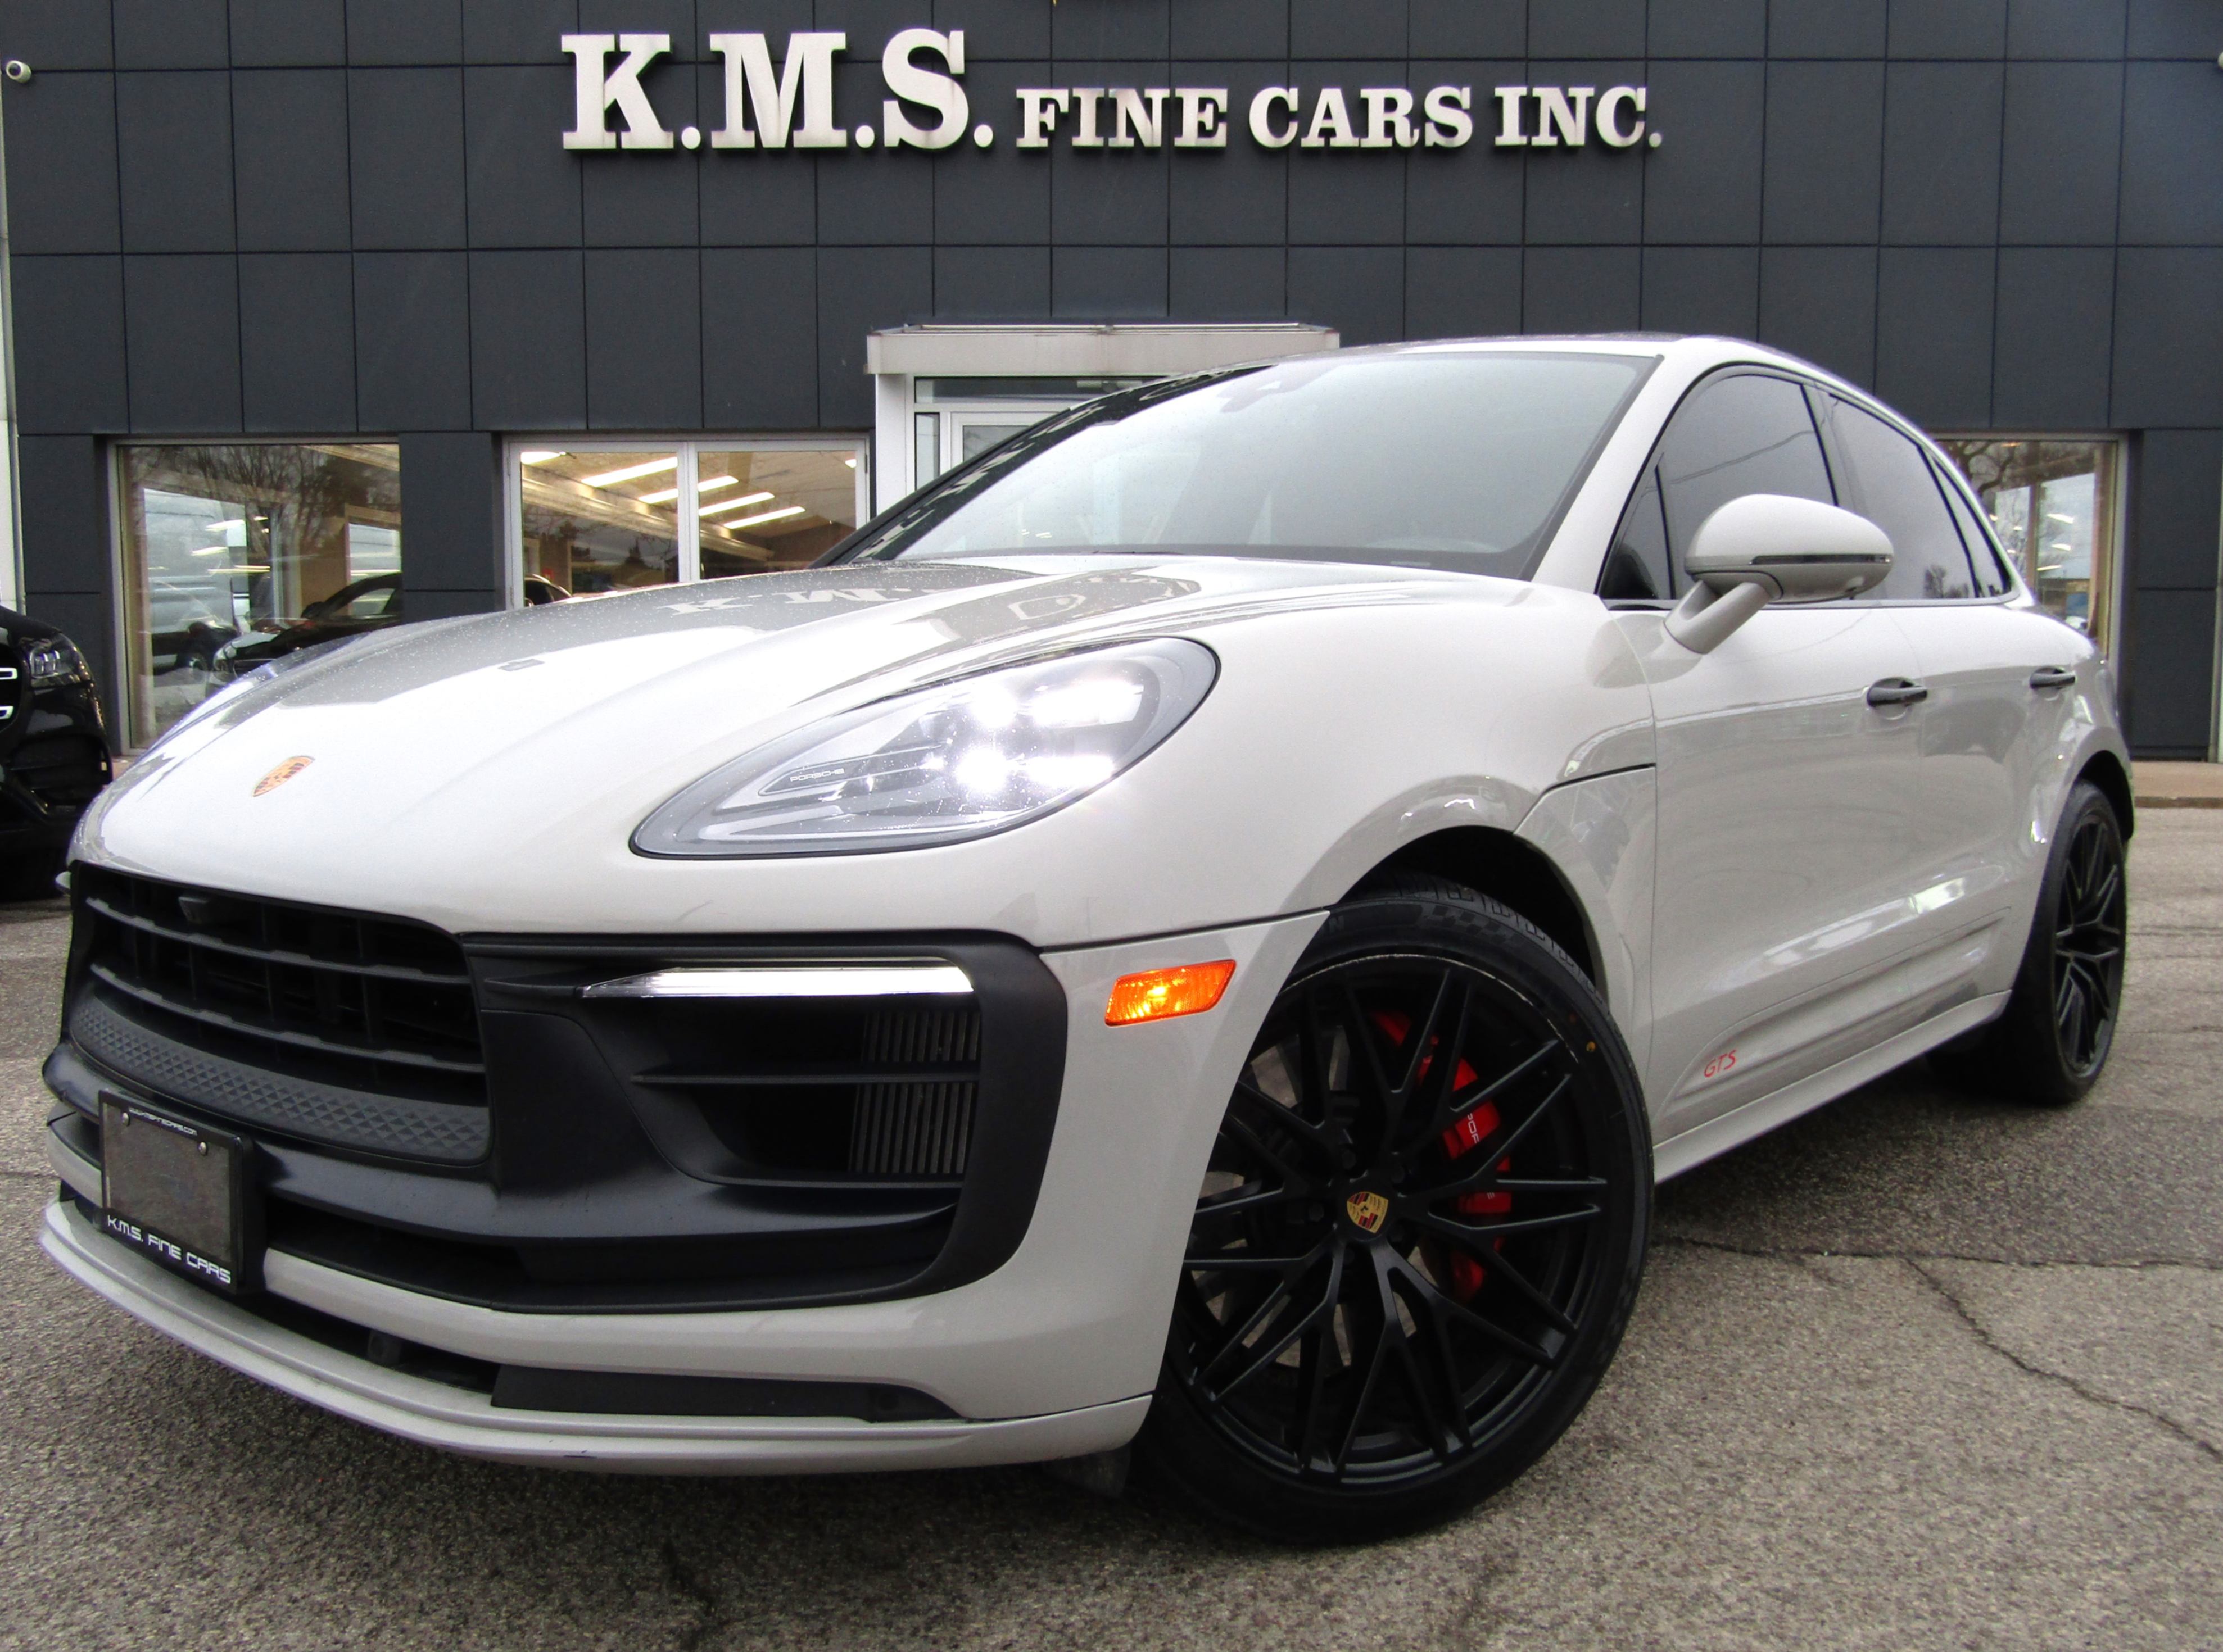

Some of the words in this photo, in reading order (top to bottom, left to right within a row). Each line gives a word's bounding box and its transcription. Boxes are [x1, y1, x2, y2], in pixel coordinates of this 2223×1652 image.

[561, 28, 994, 150] K.M.S.
[1016, 88, 1228, 148] FINE
[1248, 86, 1474, 148] CARS
[1494, 86, 1663, 148] INC.
[789, 768, 845, 783] PORSCHE
[1704, 1049, 1737, 1078] GTS
[147, 1233, 182, 1261] FINE
[186, 1251, 231, 1285] CARS
